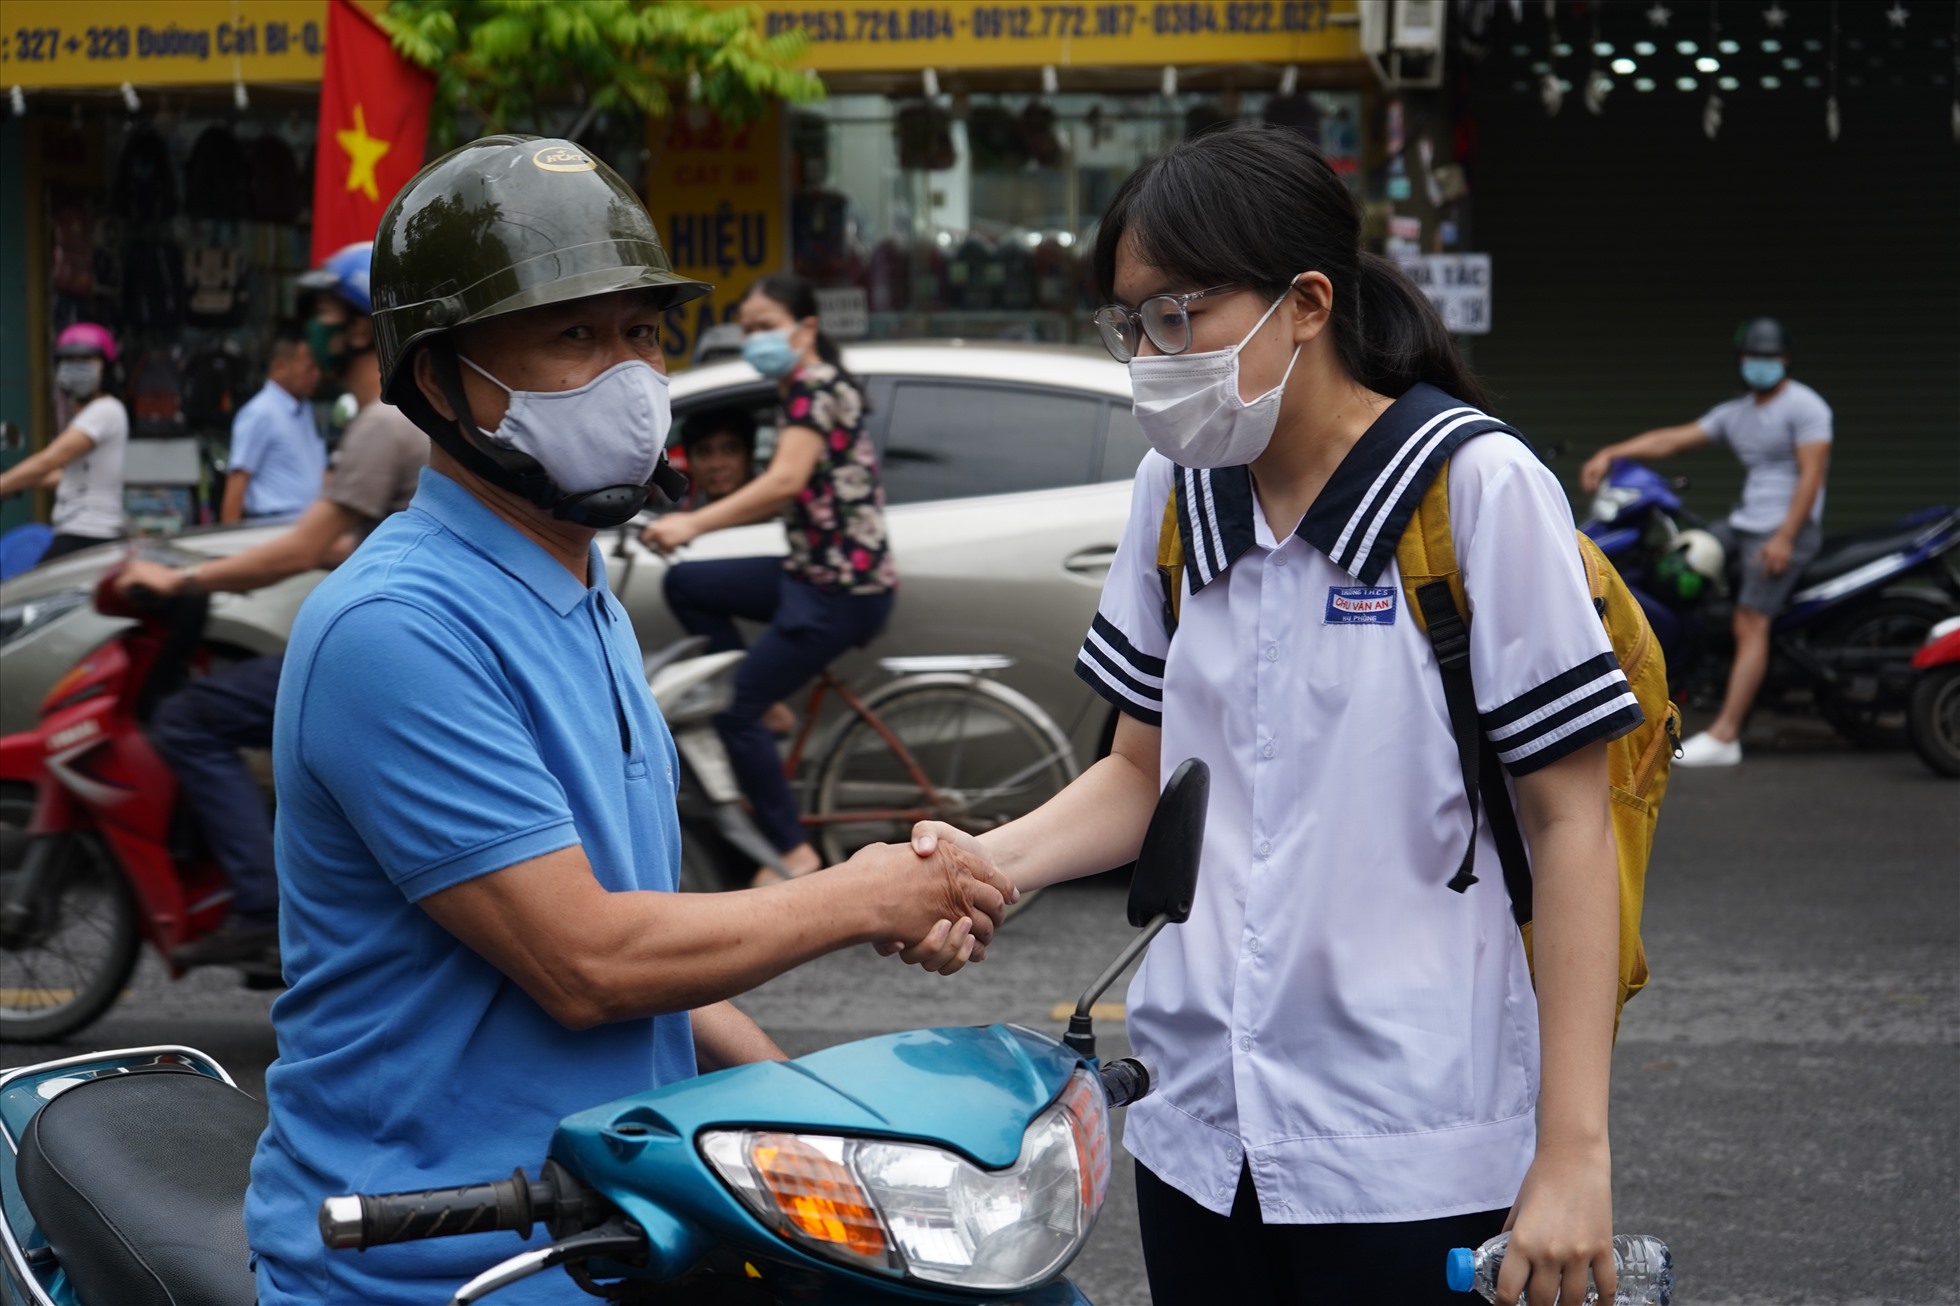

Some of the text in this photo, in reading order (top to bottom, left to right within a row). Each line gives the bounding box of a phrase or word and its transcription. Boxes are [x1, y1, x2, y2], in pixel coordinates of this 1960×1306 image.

[216, 15, 258, 55] Cát
[670, 201, 766, 277] HIỆU
[1335, 597, 1389, 611] CHU VĂN AN
